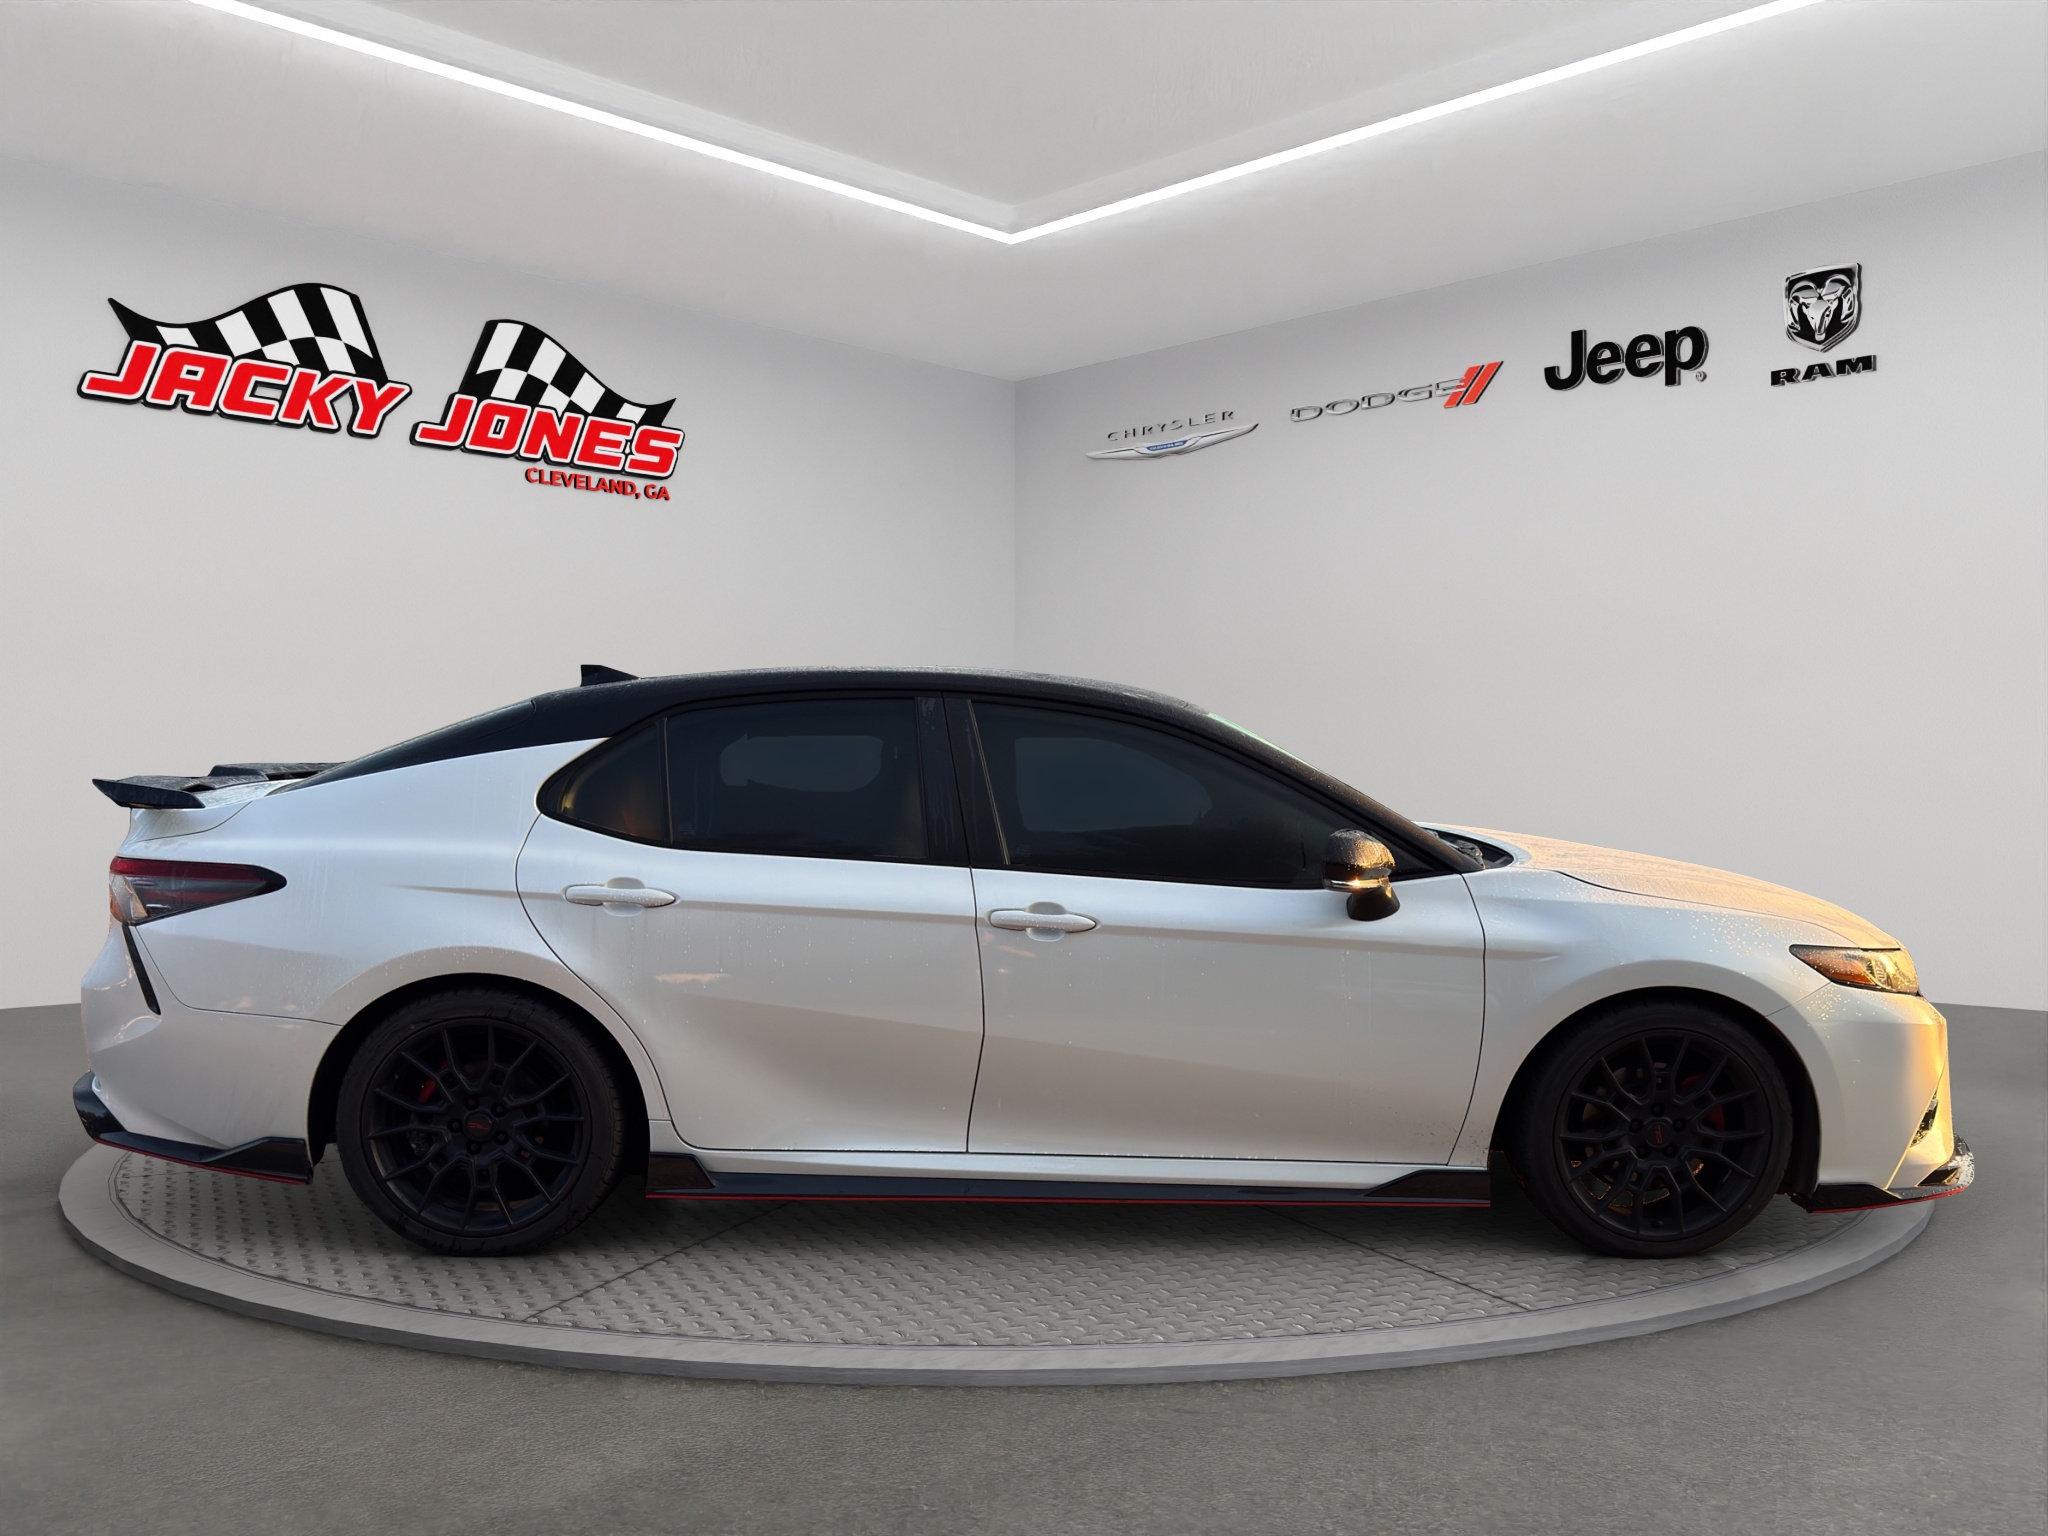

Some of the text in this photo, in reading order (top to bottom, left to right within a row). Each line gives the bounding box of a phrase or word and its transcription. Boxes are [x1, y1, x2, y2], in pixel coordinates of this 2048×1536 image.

[1544, 326, 1708, 391] Jeep
[1770, 355, 1877, 387] RAM
[80, 339, 685, 479] JACKY JONES
[1290, 378, 1467, 423] DODGE
[1107, 410, 1236, 442] CHRYSLER
[525, 467, 671, 501] CLEVELAND, GA
